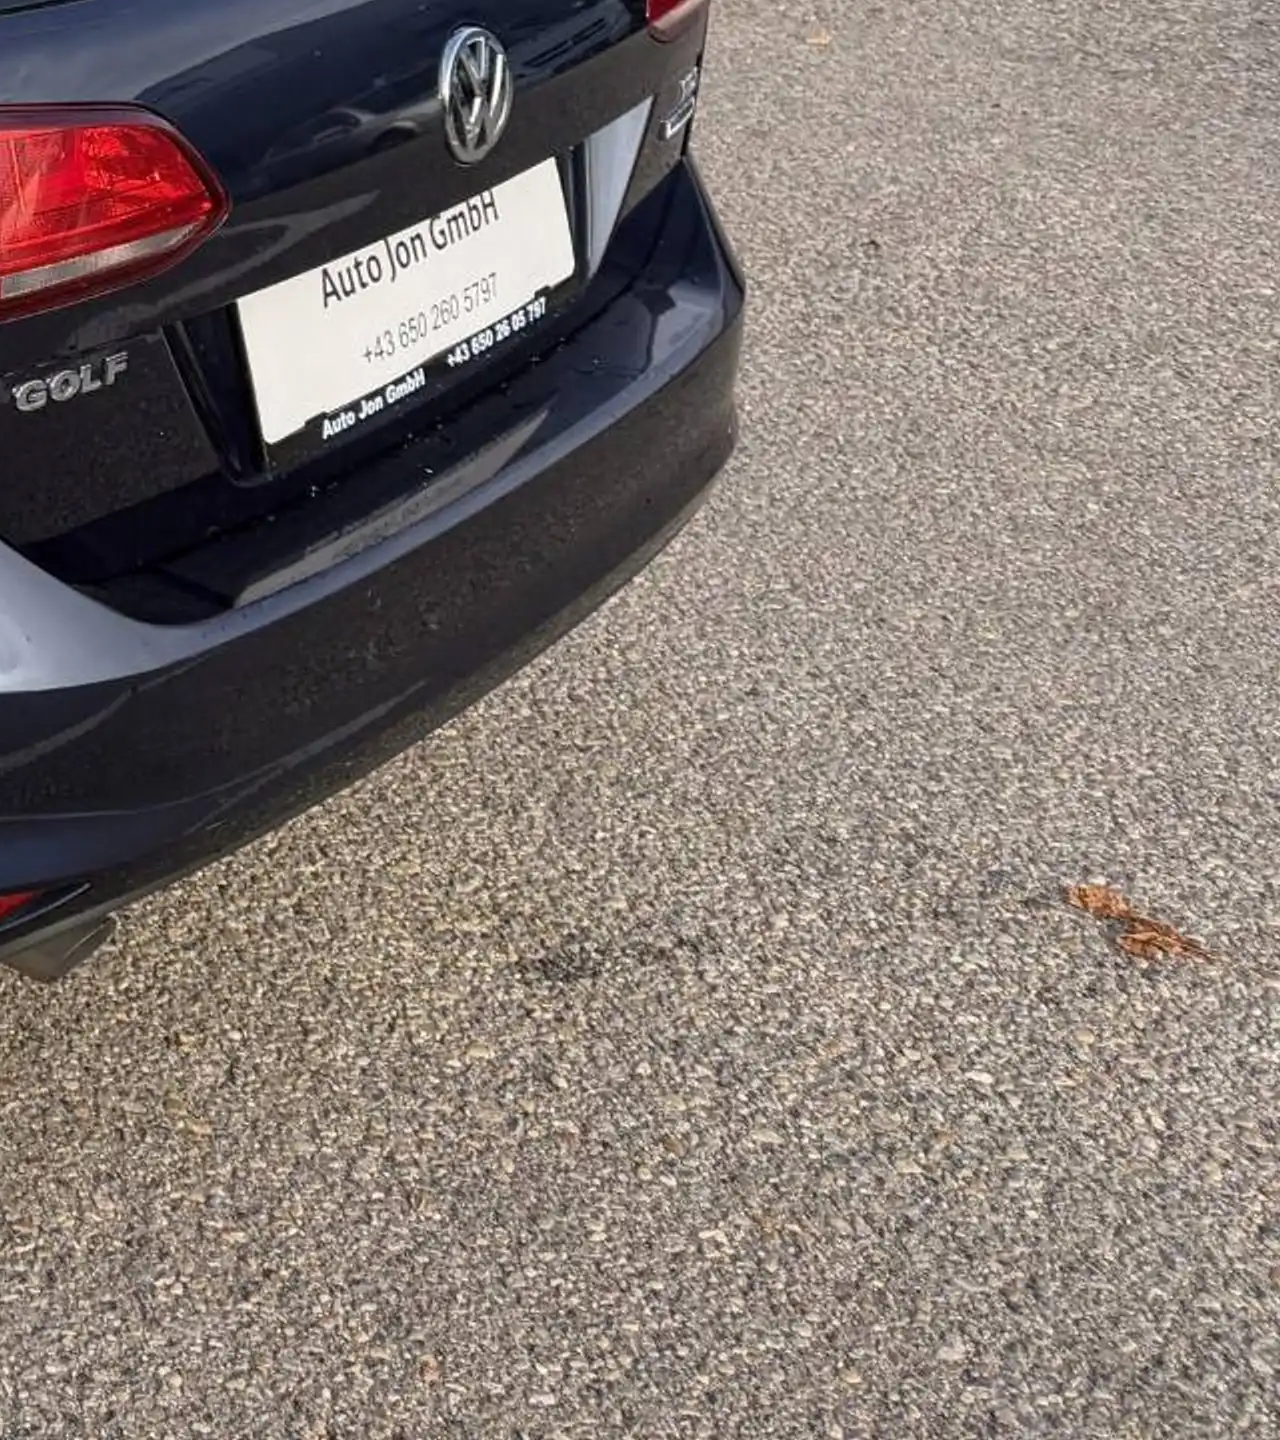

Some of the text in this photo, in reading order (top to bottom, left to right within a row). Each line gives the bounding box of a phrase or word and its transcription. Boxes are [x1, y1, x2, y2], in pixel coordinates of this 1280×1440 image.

[320, 188, 500, 309] Auto Jon GmbH
[362, 272, 498, 364] +43 650 260 5797
[447, 295, 547, 367] +43 650 26 05 797
[12, 351, 128, 411] GOLF
[320, 366, 426, 440] Auto Jon GmbH
